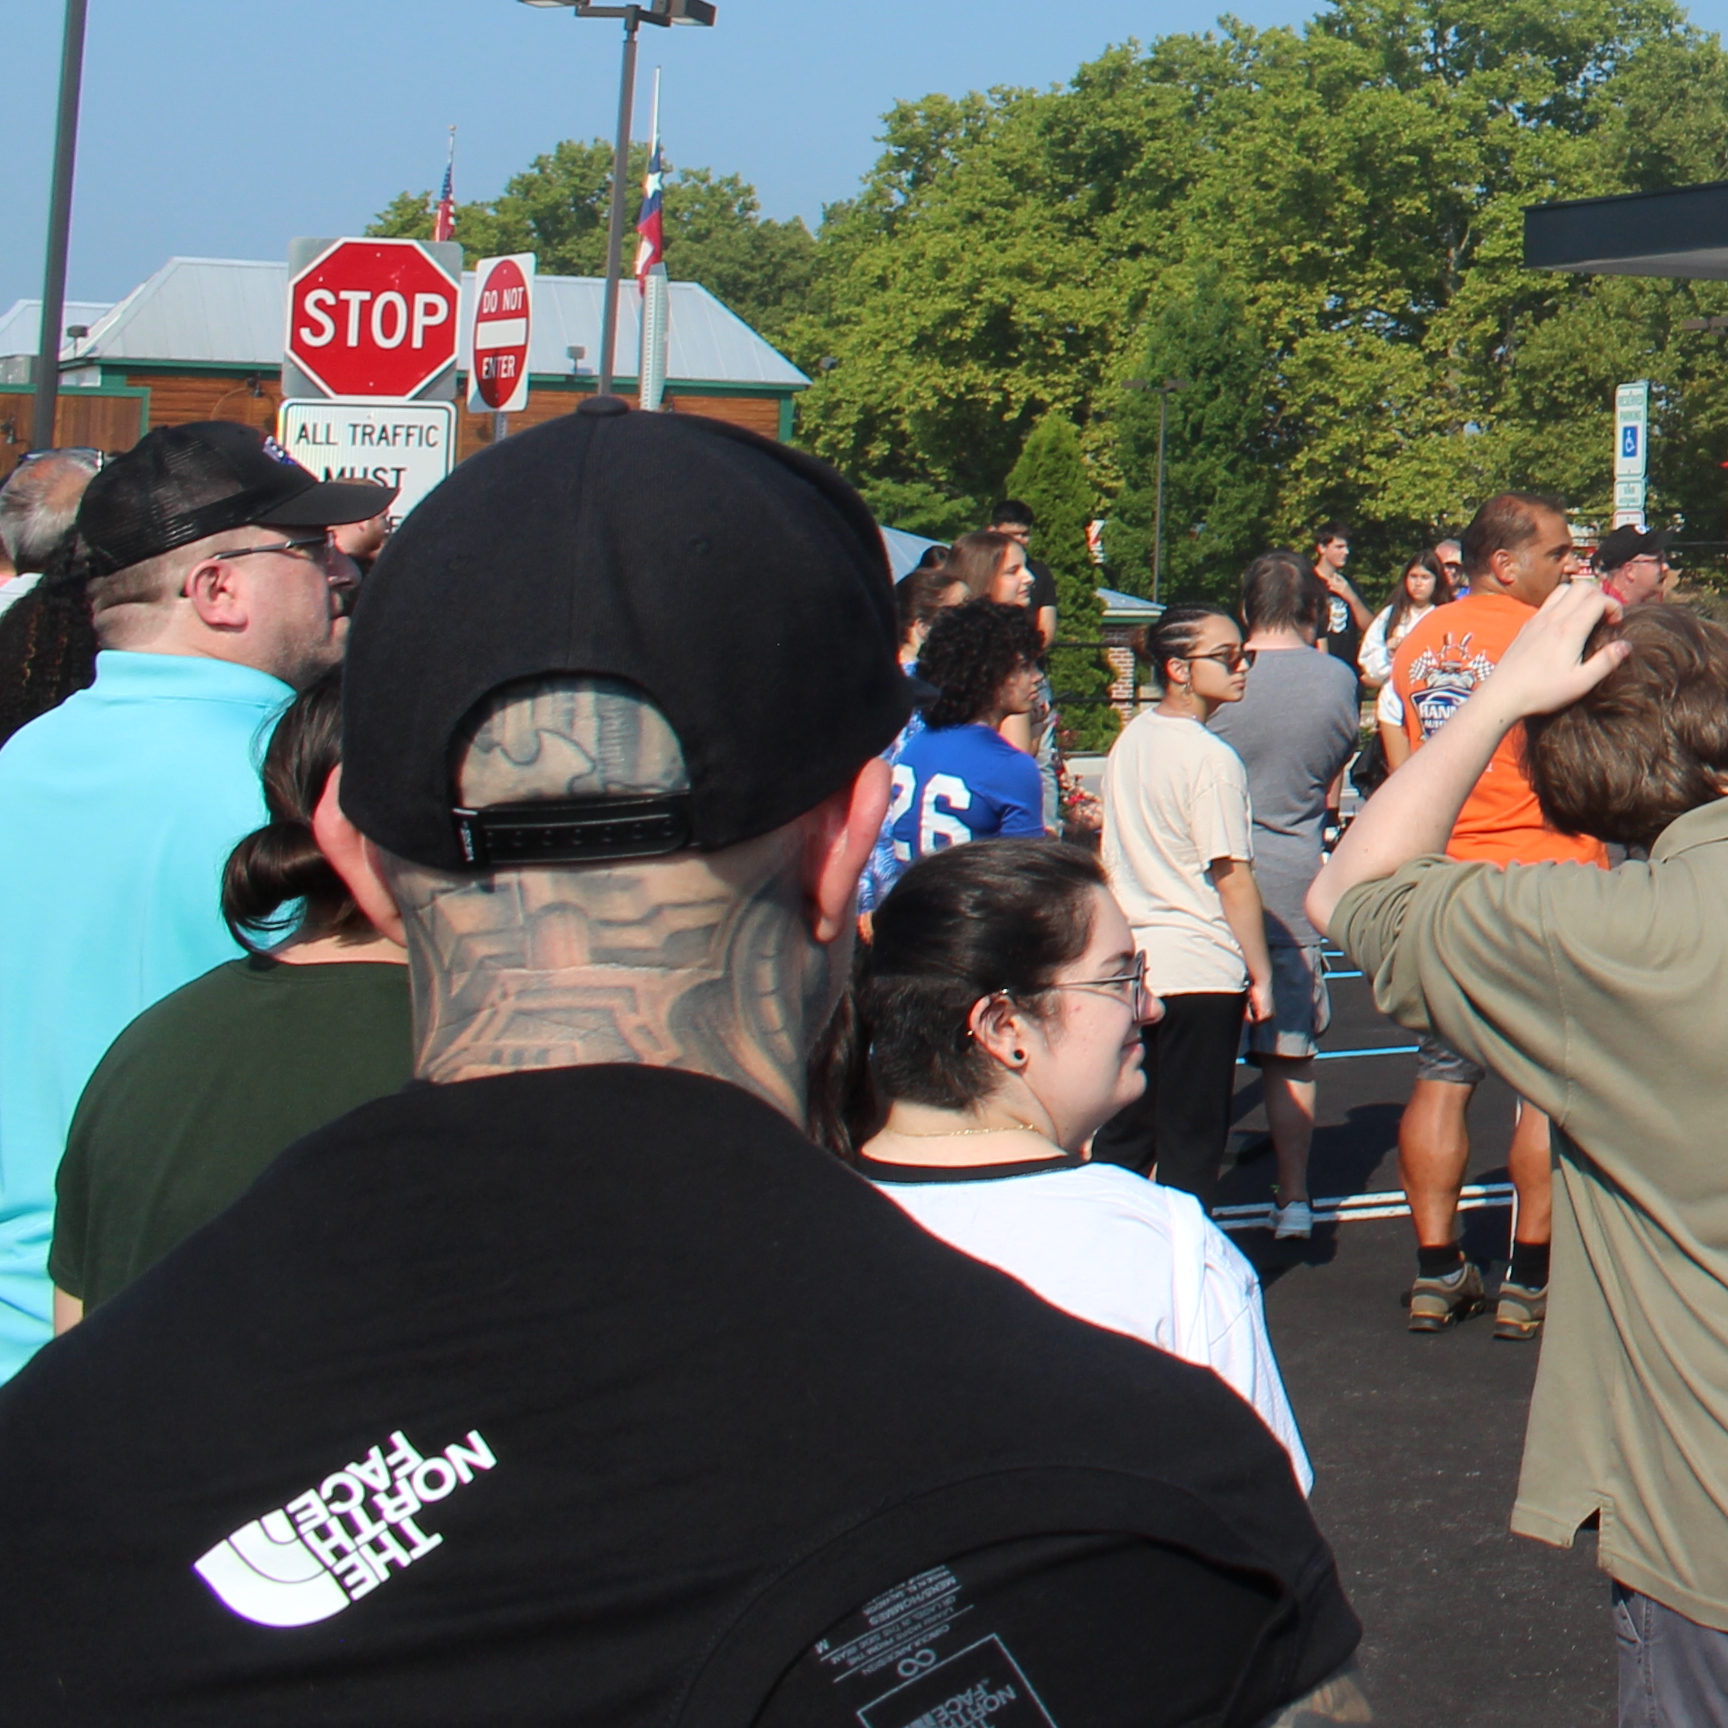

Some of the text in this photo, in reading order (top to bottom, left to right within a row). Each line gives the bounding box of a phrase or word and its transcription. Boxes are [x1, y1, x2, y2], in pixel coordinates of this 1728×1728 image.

[299, 288, 449, 349] STOP
[483, 287, 525, 314] DO NOT
[482, 355, 516, 380] ENTER
[295, 423, 439, 448] ALL TRAFFIC
[284, 1429, 427, 1536] FACE
[299, 1429, 498, 1576] NORTH
[331, 1516, 444, 1601] THE
[813, 1638, 830, 1654] M
[930, 1683, 988, 1724] FACE
